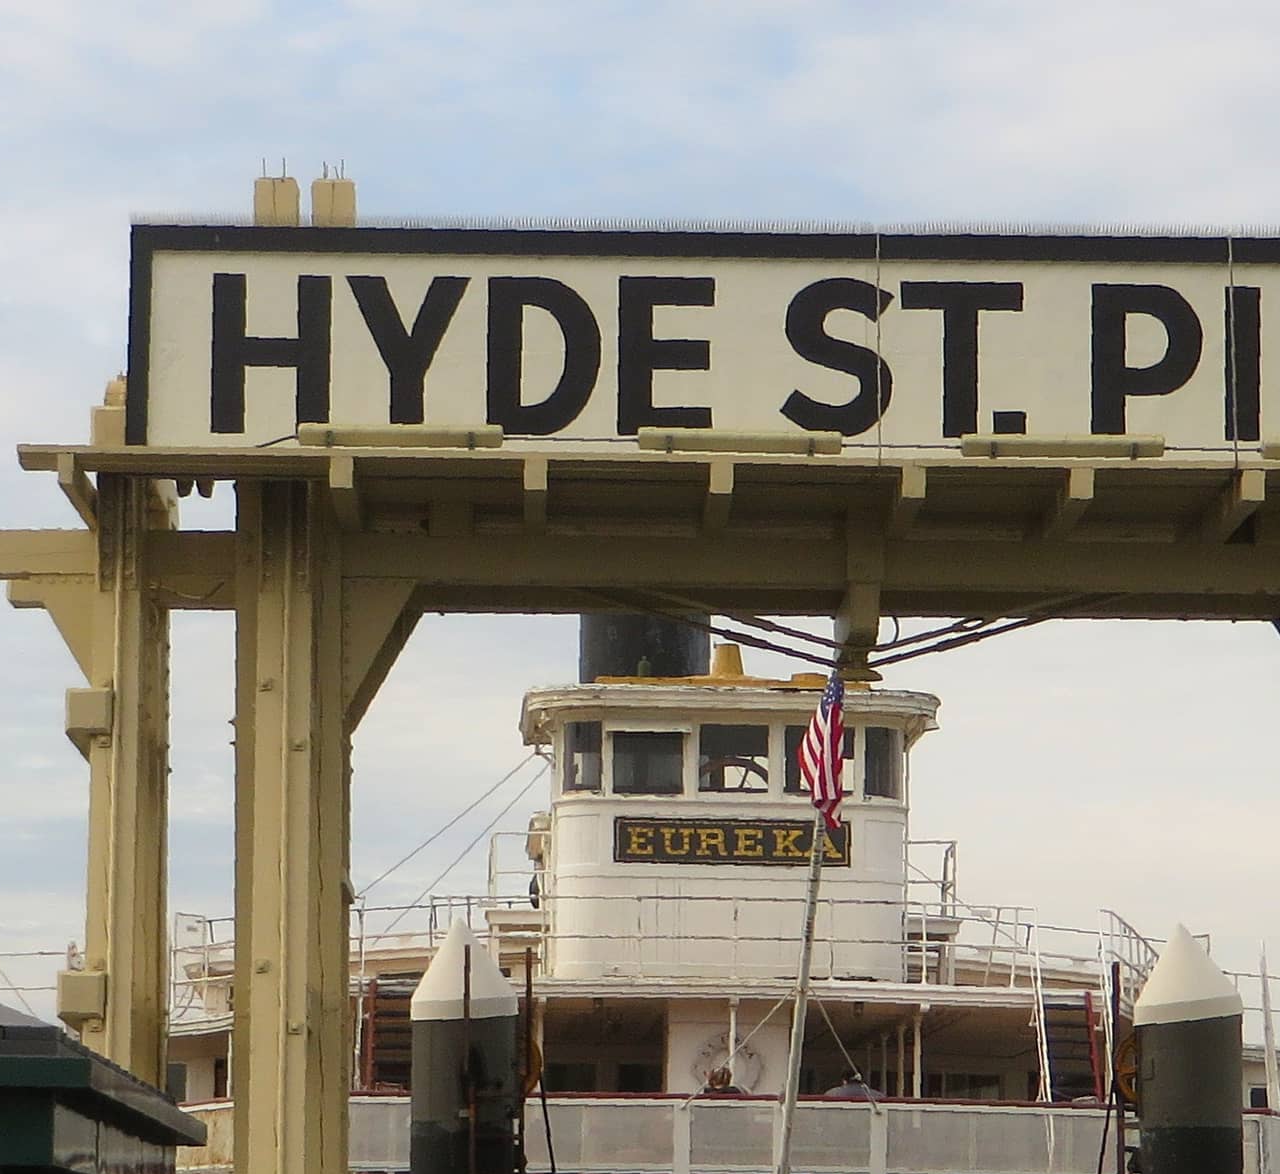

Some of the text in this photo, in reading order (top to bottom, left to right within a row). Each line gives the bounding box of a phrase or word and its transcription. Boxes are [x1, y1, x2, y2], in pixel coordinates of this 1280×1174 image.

[209, 272, 717, 437] HYDE
[779, 276, 1028, 438] ST.
[626, 826, 843, 859] EUREKA
